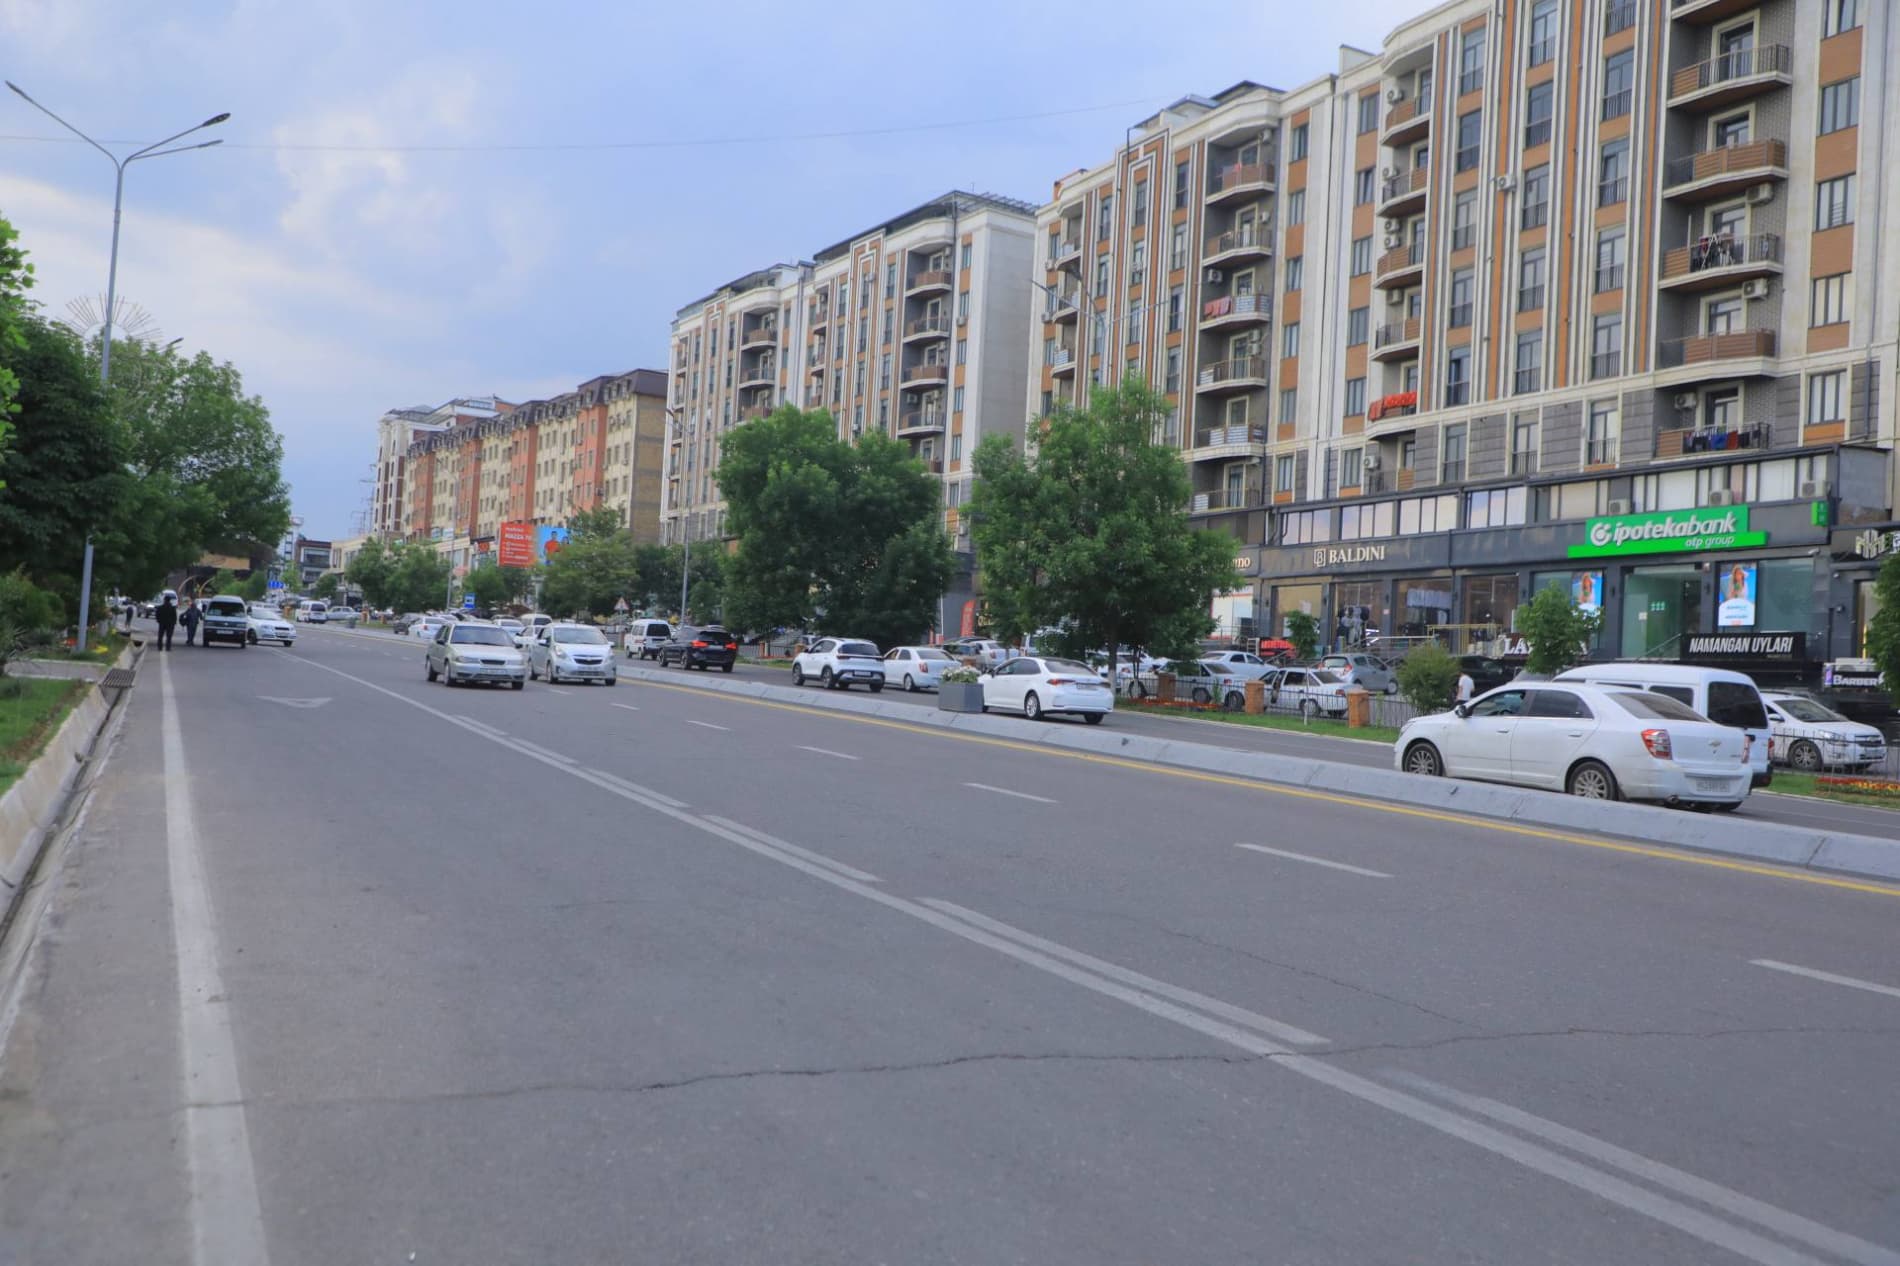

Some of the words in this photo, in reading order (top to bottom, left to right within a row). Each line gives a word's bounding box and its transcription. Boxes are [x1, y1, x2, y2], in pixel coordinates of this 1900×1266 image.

[1614, 511, 1737, 546] ipotekabank
[1685, 537, 1703, 549] otp
[1705, 535, 1735, 549] group
[1329, 545, 1385, 563] BALDINI
[1689, 637, 1751, 653] NAMANGAN
[1751, 637, 1794, 653] UYLARI
